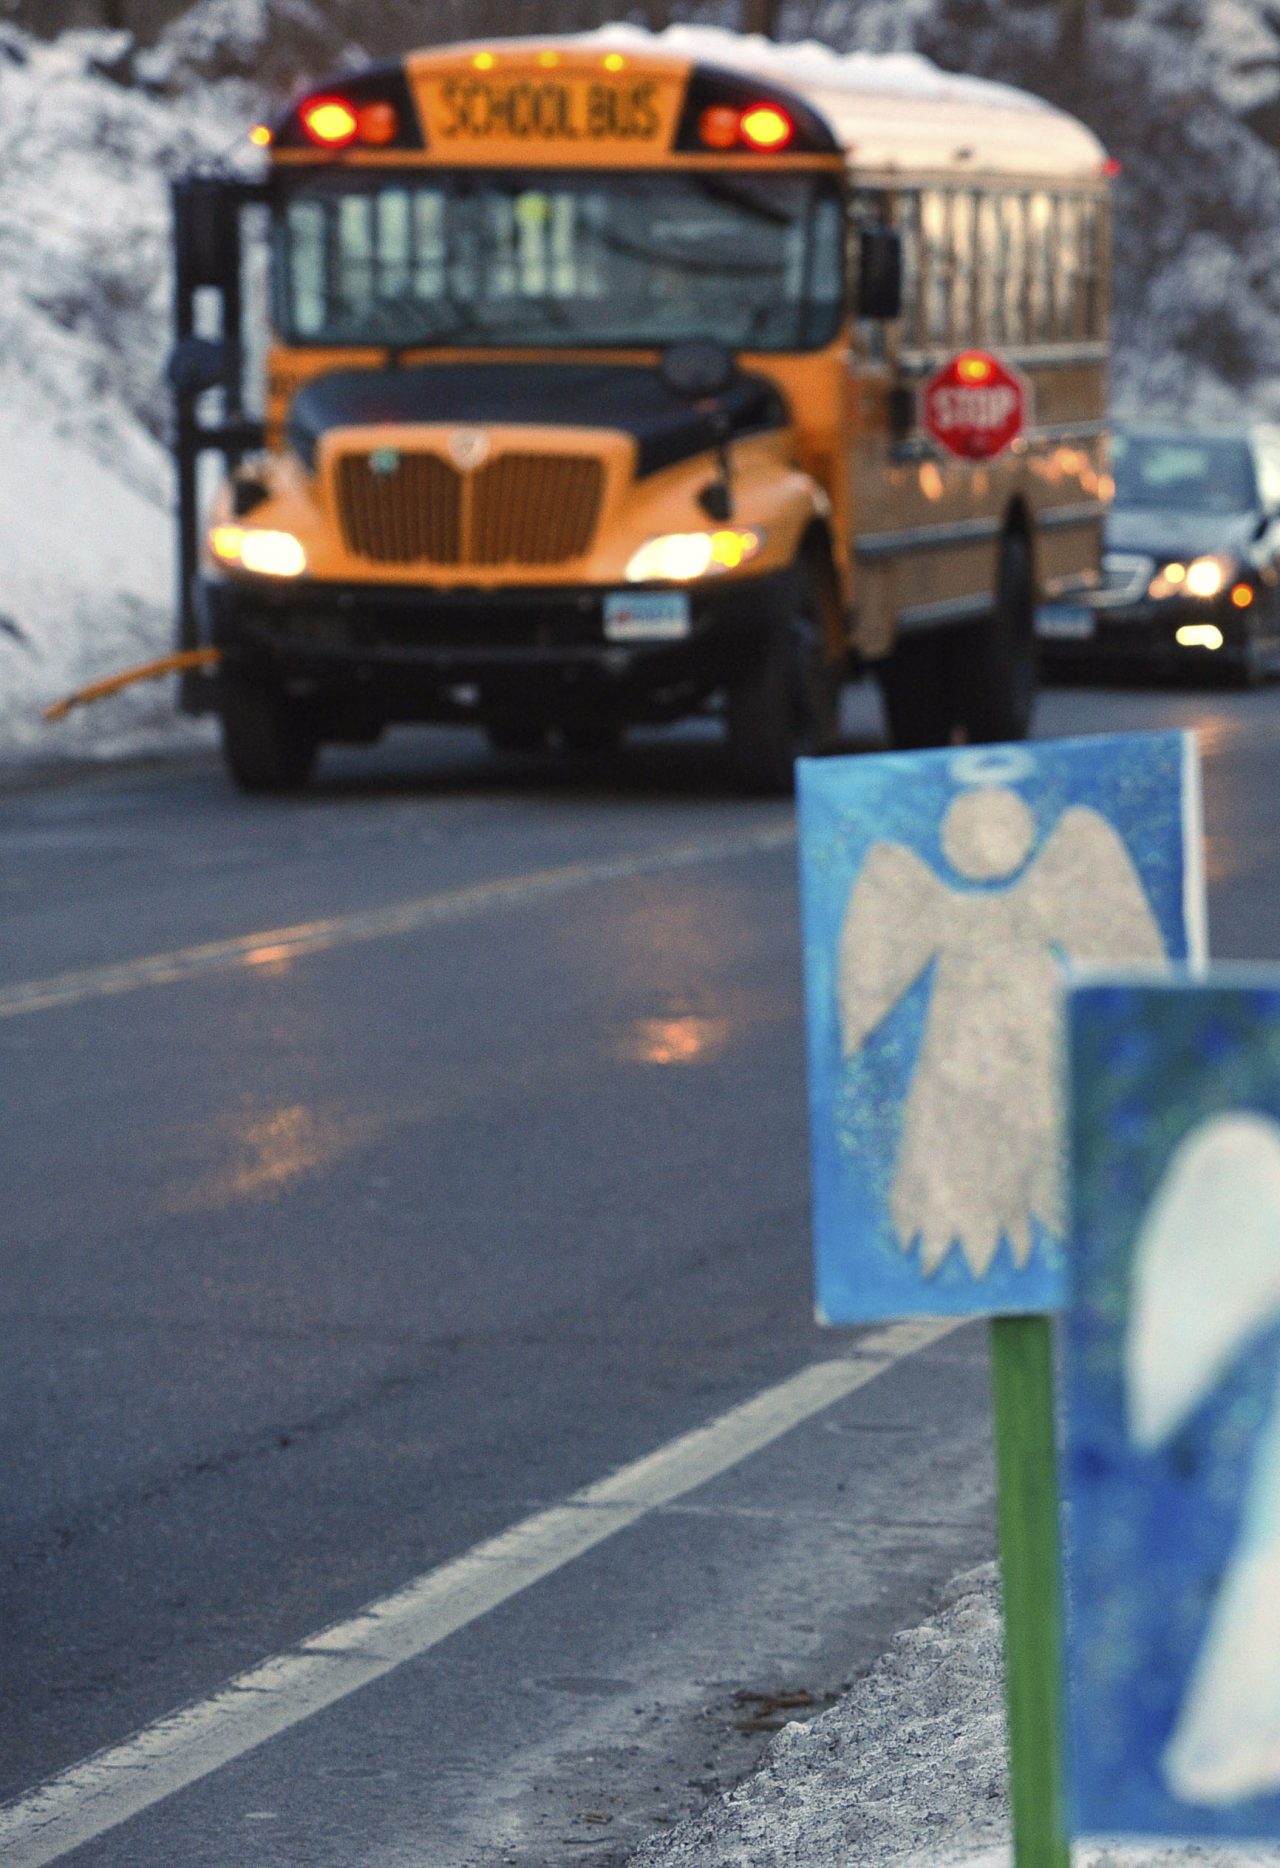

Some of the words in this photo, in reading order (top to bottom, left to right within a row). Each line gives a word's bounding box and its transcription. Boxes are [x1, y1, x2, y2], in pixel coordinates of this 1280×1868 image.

[440, 78, 577, 138] SCHOOL
[586, 82, 659, 139] BUS
[934, 386, 1014, 430] STOP
